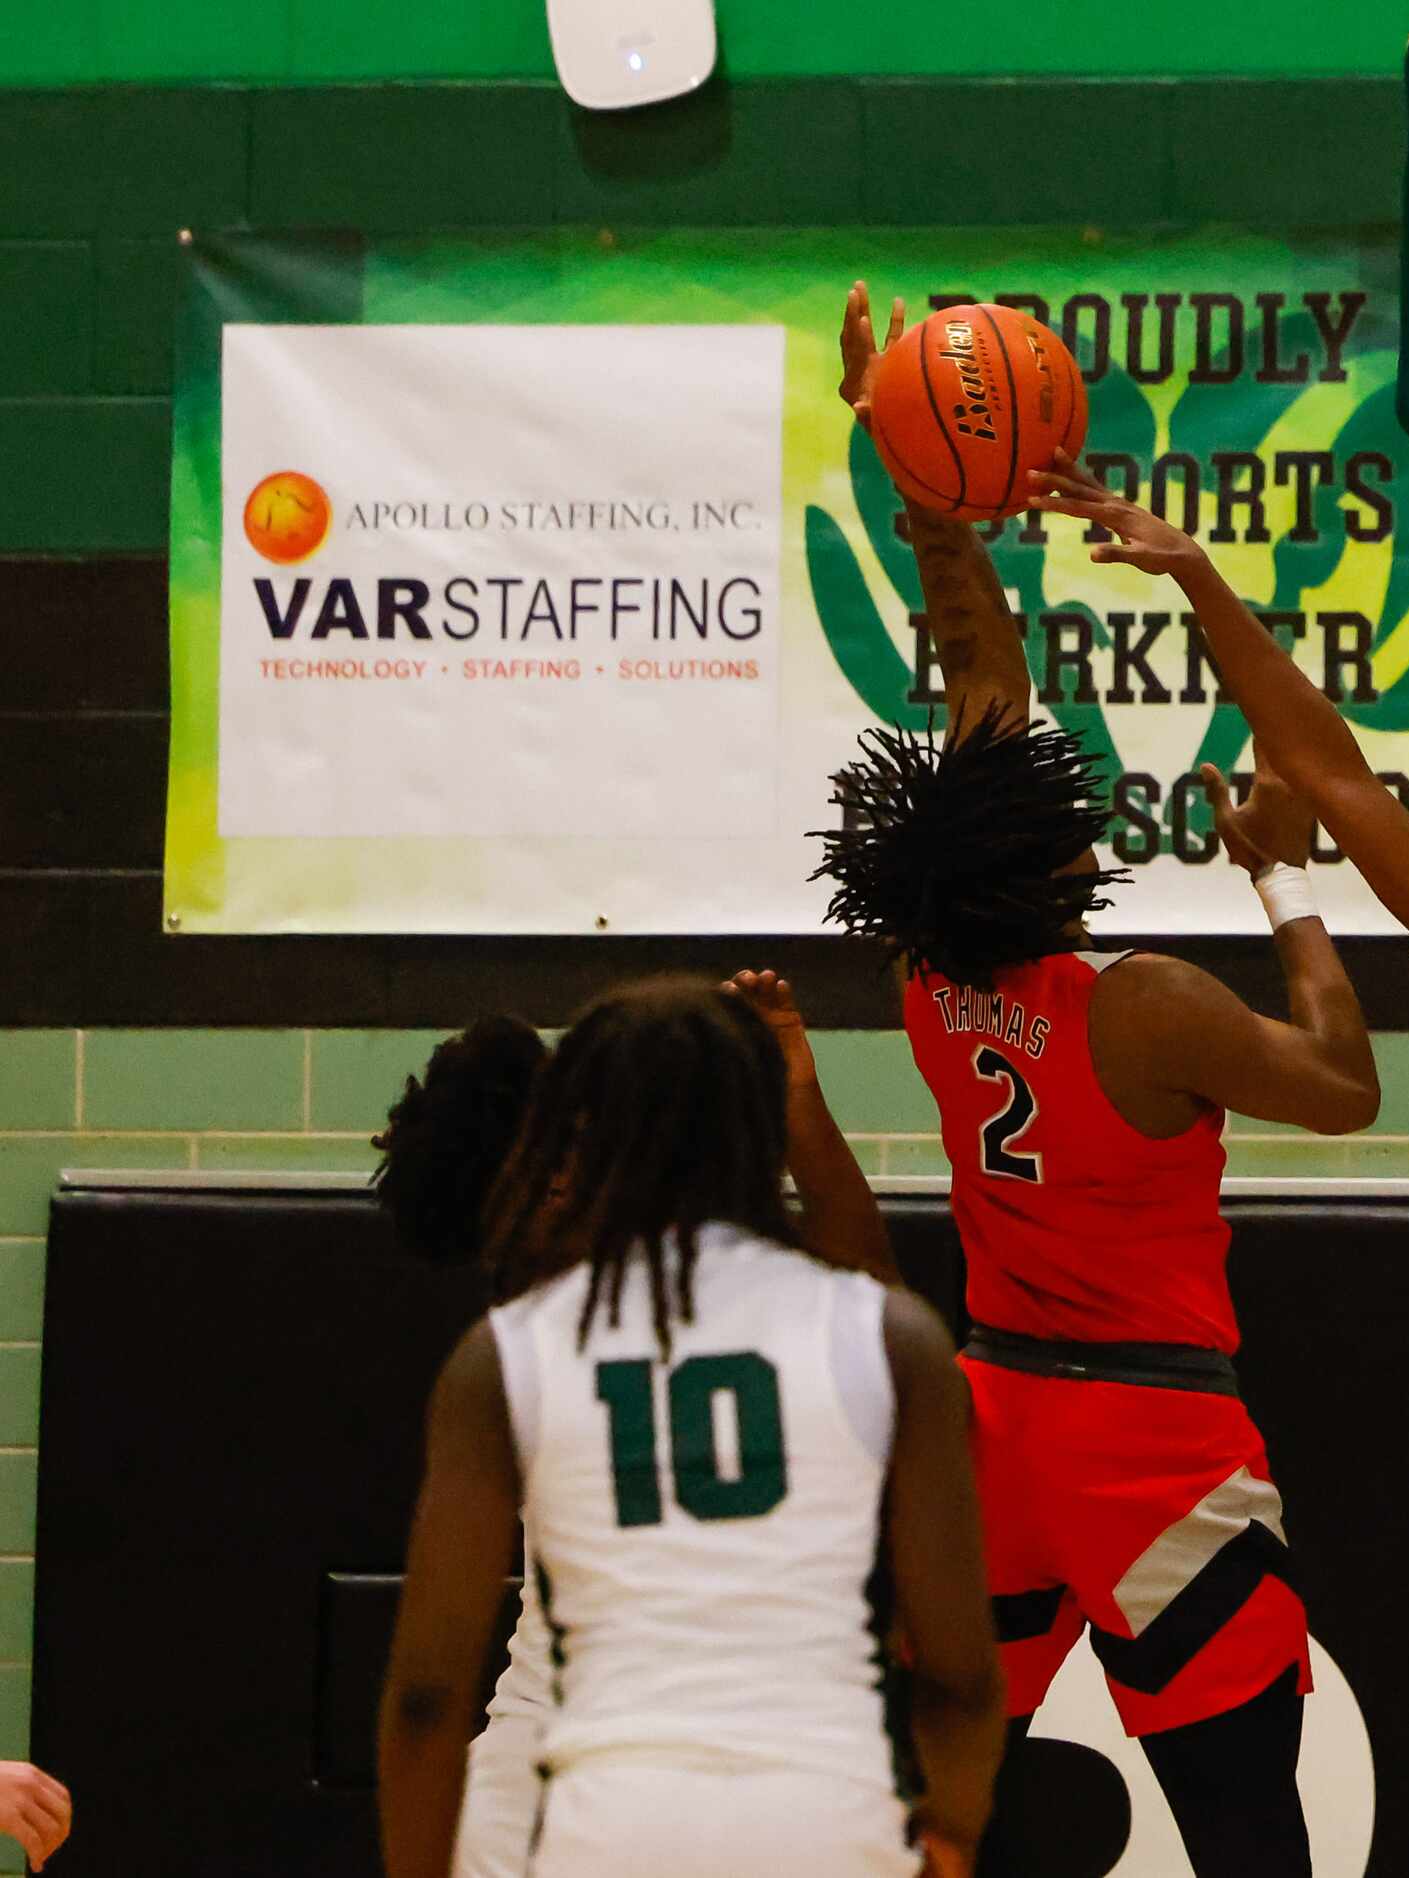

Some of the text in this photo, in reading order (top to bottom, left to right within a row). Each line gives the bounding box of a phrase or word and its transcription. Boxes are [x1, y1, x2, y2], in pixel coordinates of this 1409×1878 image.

[928, 293, 1367, 384] OUDLY
[939, 318, 998, 441] Baden
[347, 501, 762, 531] APOLLO STAFFING, INC.
[893, 450, 1394, 545] PORTS
[259, 658, 760, 681] TECHNOLOGY STAFFING SOLUTIONS
[907, 612, 1379, 704] BRKNR
[933, 985, 1051, 1059] THOMAS
[970, 1043, 1044, 1184] 2
[594, 1351, 788, 1528] 10
